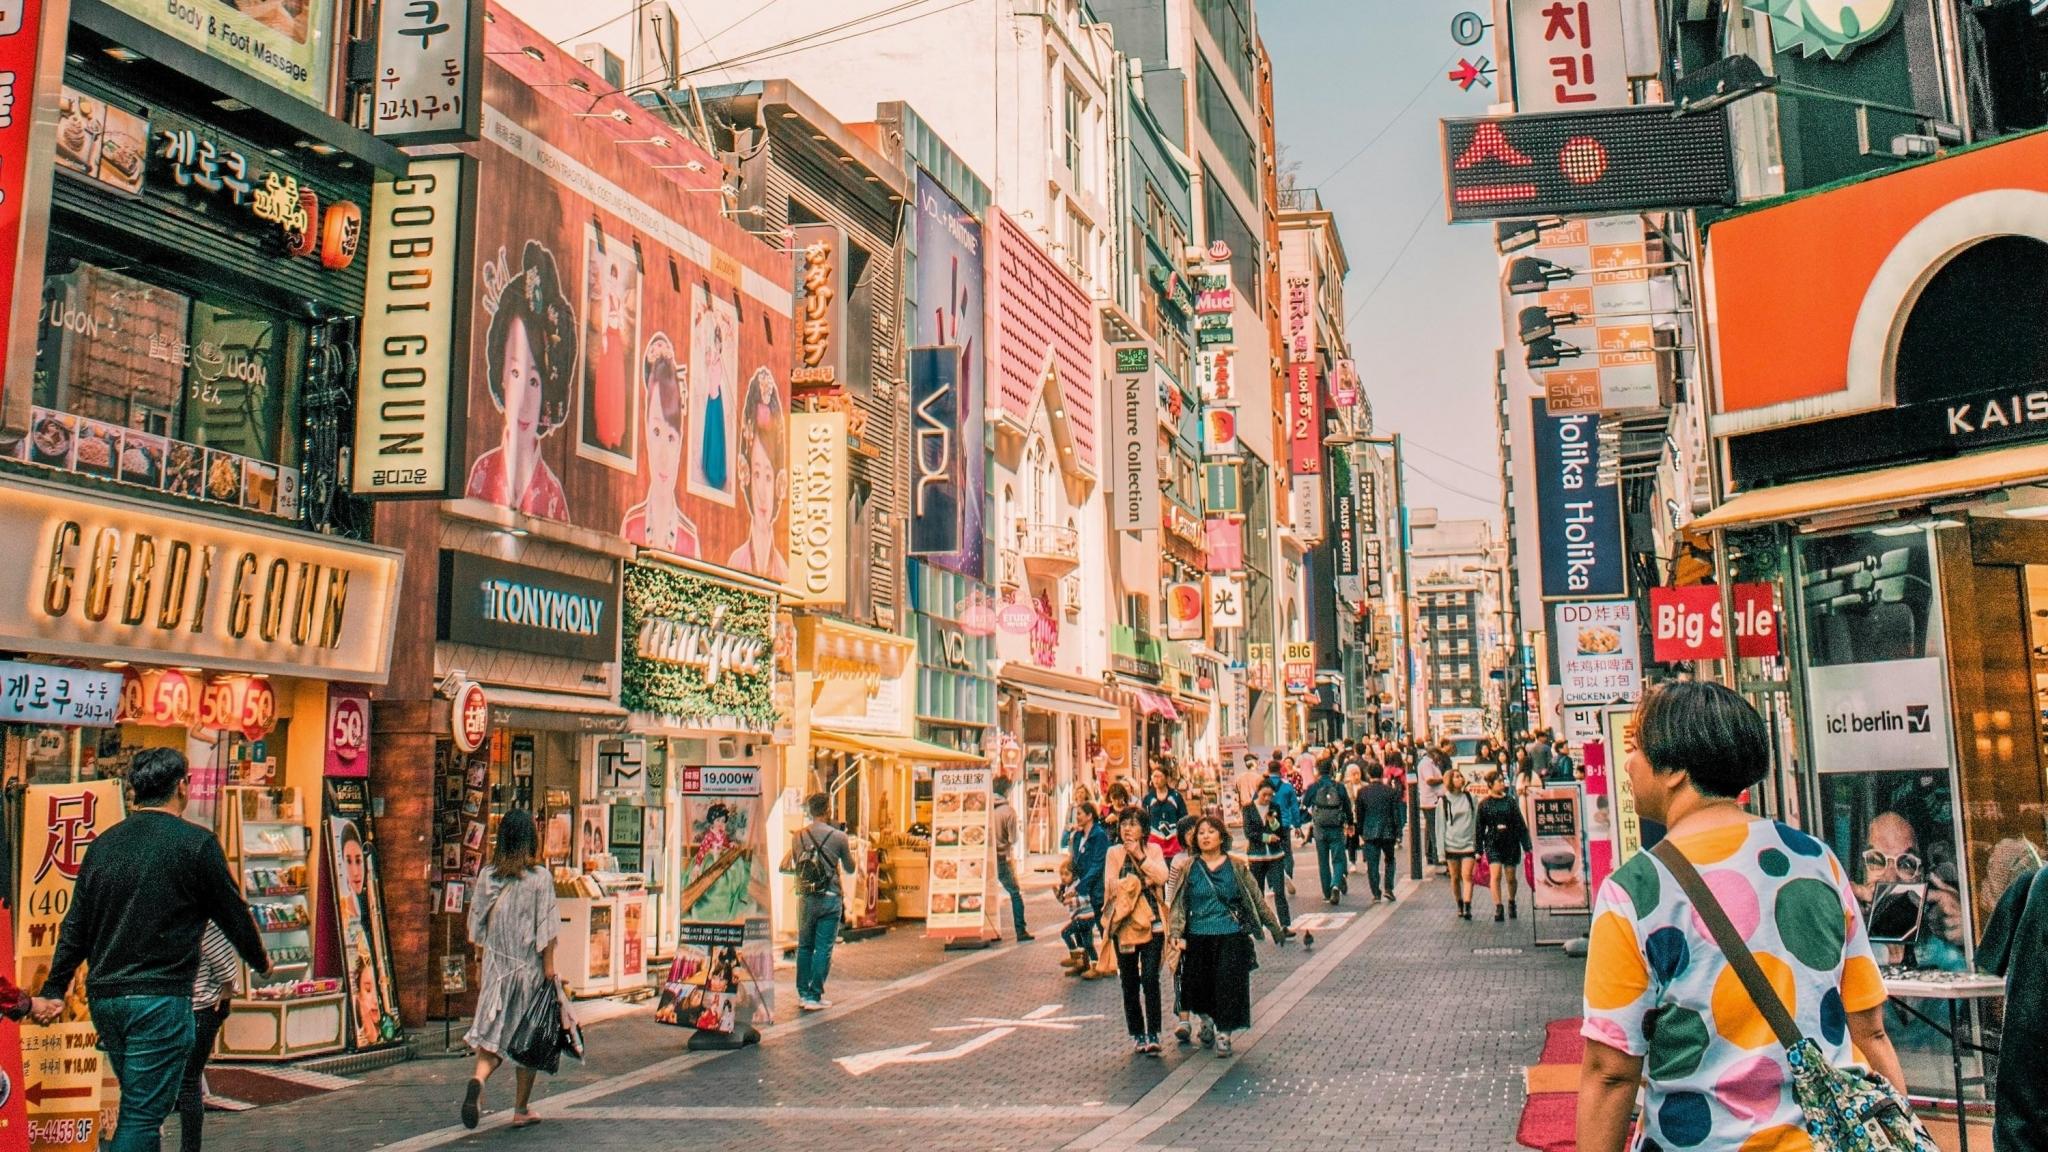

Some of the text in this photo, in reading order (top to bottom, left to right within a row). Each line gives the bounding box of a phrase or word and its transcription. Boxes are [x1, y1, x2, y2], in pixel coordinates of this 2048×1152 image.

[167, 0, 203, 31] Body
[221, 23, 250, 55] Foot
[254, 39, 308, 83] Massage
[1541, 1, 1597, 104] 치킨
[379, 95, 460, 121] 꼬치구이
[379, 172, 436, 457] GOBDI GOUN
[1196, 290, 1233, 311] Mud
[1551, 385, 1595, 400] style
[1552, 396, 1597, 409] mall
[917, 383, 949, 518] VDL
[1126, 378, 1142, 523] Nature Collection
[807, 423, 833, 594] SKINFOOD
[1340, 496, 1352, 573] HOLLYS COFFEE
[1564, 500, 1596, 591] Holika
[43, 519, 350, 650] GOBDI GOUN
[1214, 589, 1237, 616] 光
[487, 579, 603, 636] TONYMOLY
[1657, 604, 1703, 648] Big
[1289, 645, 1311, 658] BIG
[7, 673, 71, 716] 겐로쿠
[155, 681, 190, 722] 50
[202, 685, 234, 725] 50
[242, 688, 274, 728] 50
[335, 710, 362, 748] 50
[1826, 710, 1904, 734] ic! berlin
[77, 1119, 93, 1141] 3F
